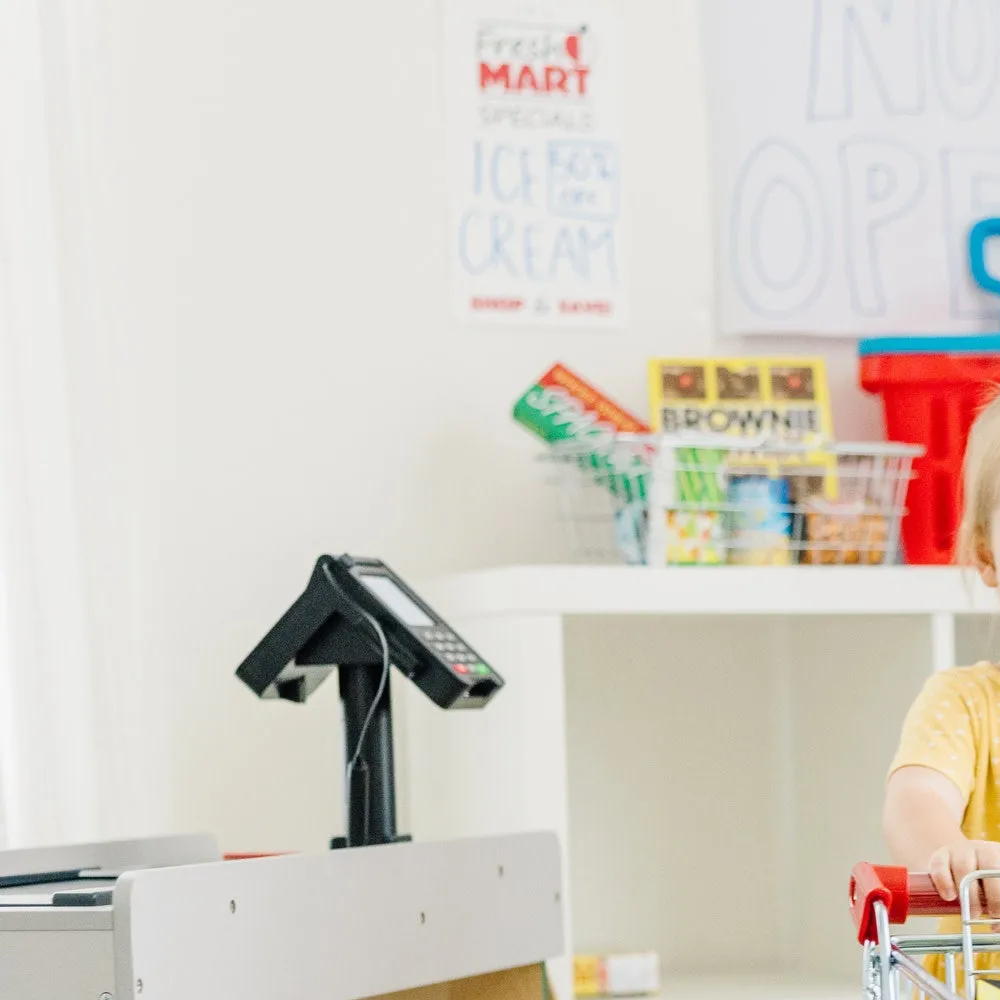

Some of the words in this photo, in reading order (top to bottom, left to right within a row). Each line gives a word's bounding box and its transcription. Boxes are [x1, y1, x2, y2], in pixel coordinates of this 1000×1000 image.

[478, 61, 589, 95] MART
[472, 139, 534, 205] ICE
[457, 205, 619, 285] CREAM
[662, 407, 817, 436] BROWNIE
